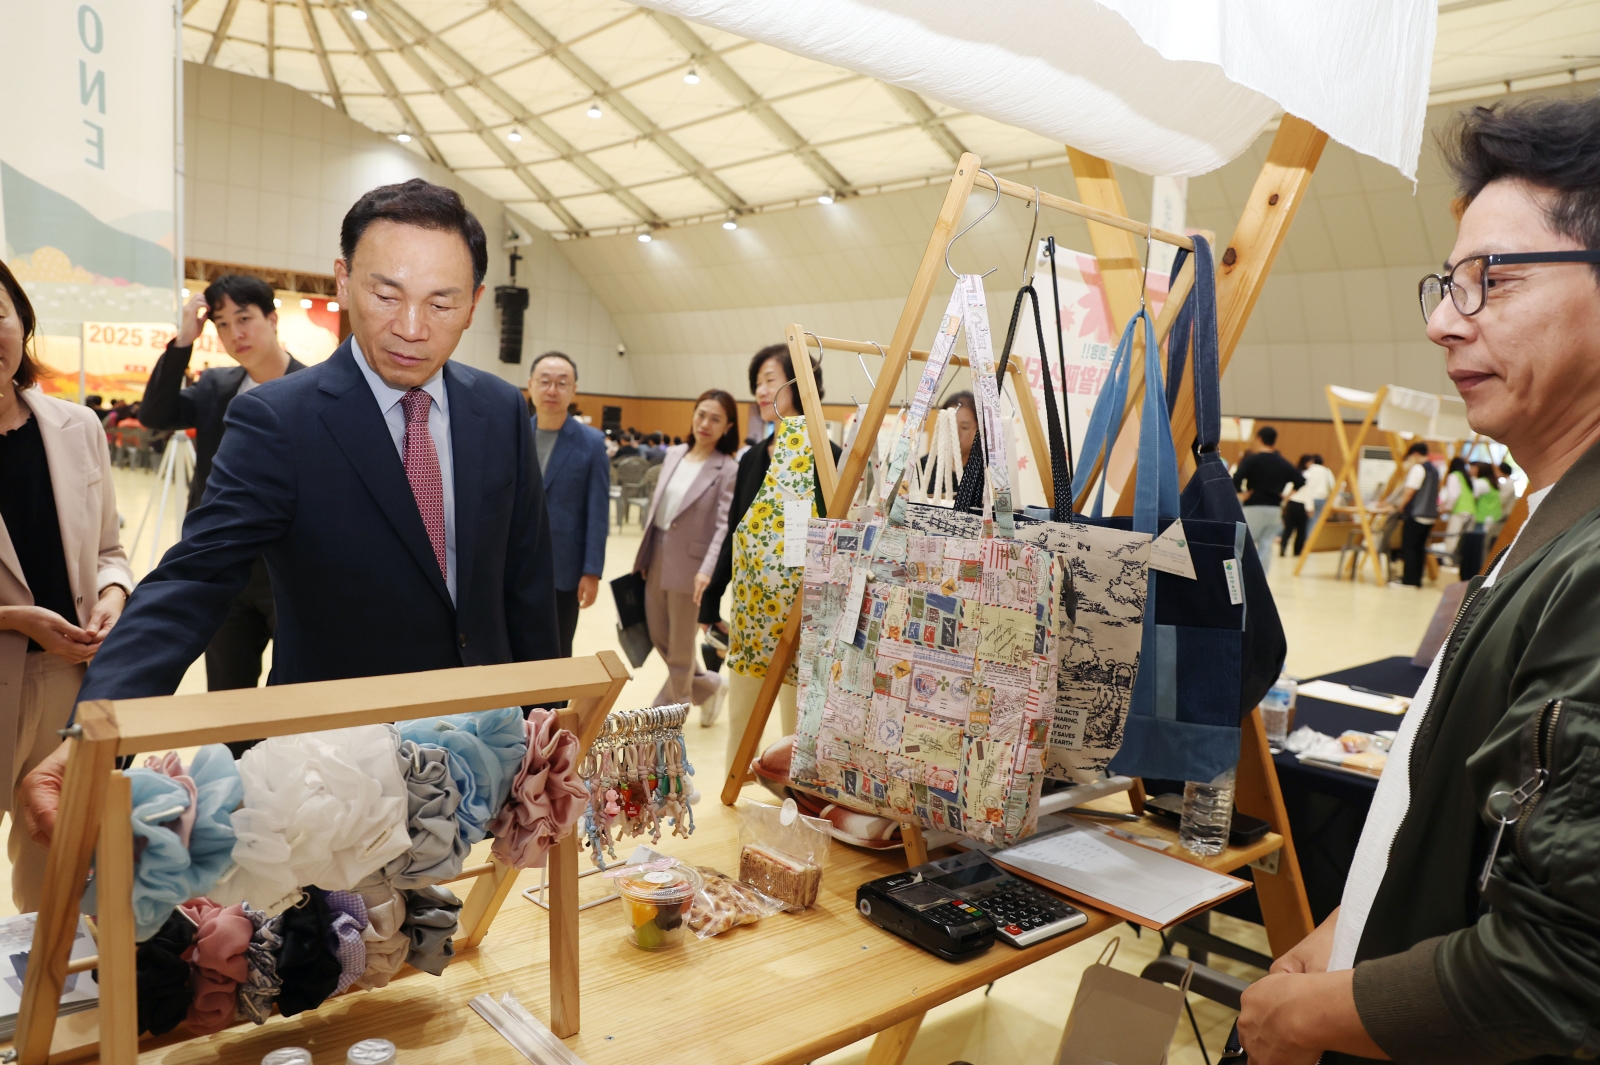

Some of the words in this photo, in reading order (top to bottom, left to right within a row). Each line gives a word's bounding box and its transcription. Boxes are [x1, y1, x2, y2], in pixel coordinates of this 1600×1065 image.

[89, 324, 143, 347] 2025
[1057, 731, 1076, 739] SAVES
[1054, 738, 1073, 746] EARTH
